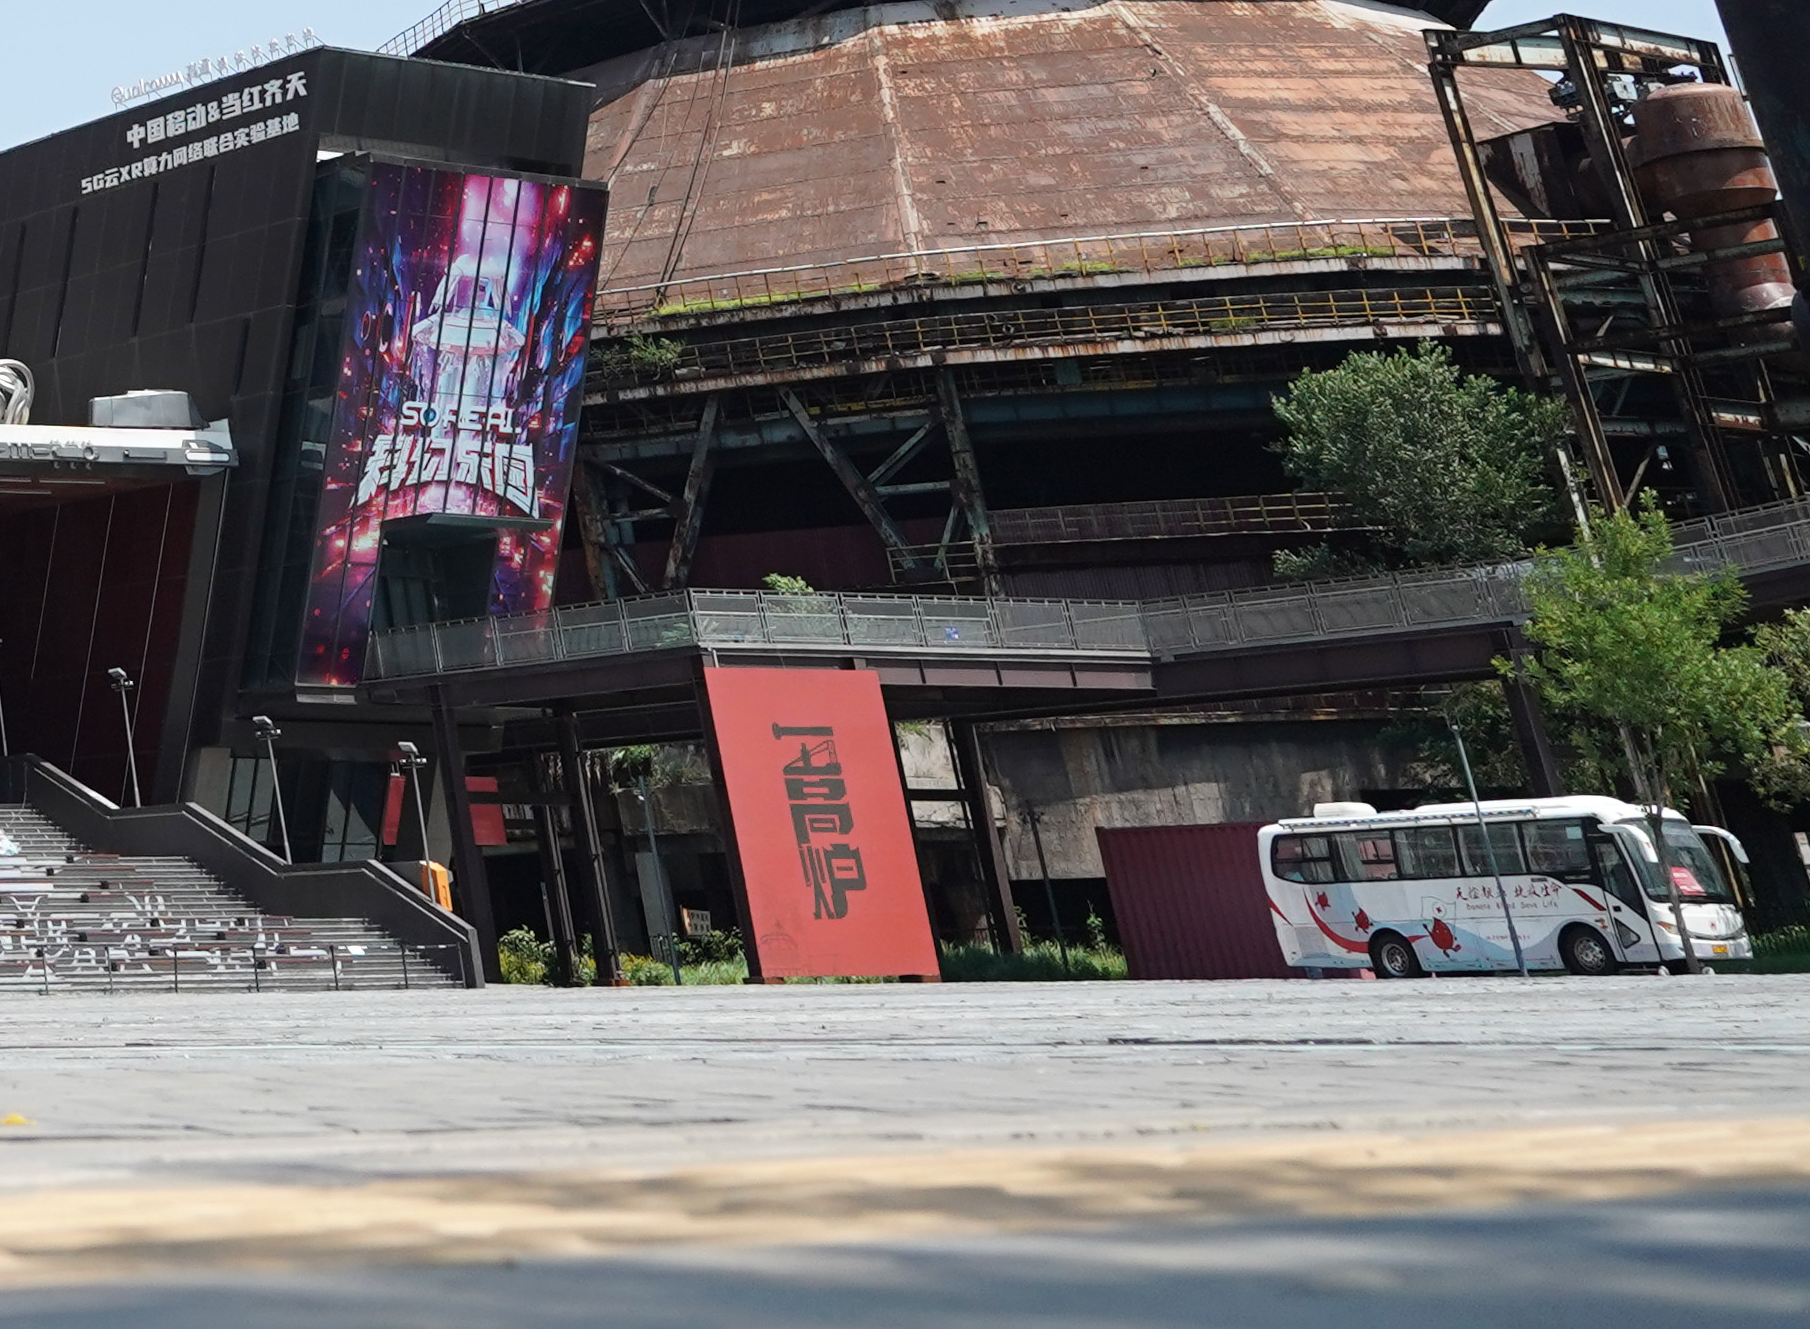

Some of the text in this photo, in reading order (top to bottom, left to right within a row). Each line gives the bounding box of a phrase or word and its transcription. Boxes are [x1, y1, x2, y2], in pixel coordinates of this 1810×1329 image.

[126, 71, 308, 149] 中国移动&当红齐天
[81, 112, 300, 195] 5G云XR算力网络联合实验基地
[349, 433, 539, 519] 科幻乐园
